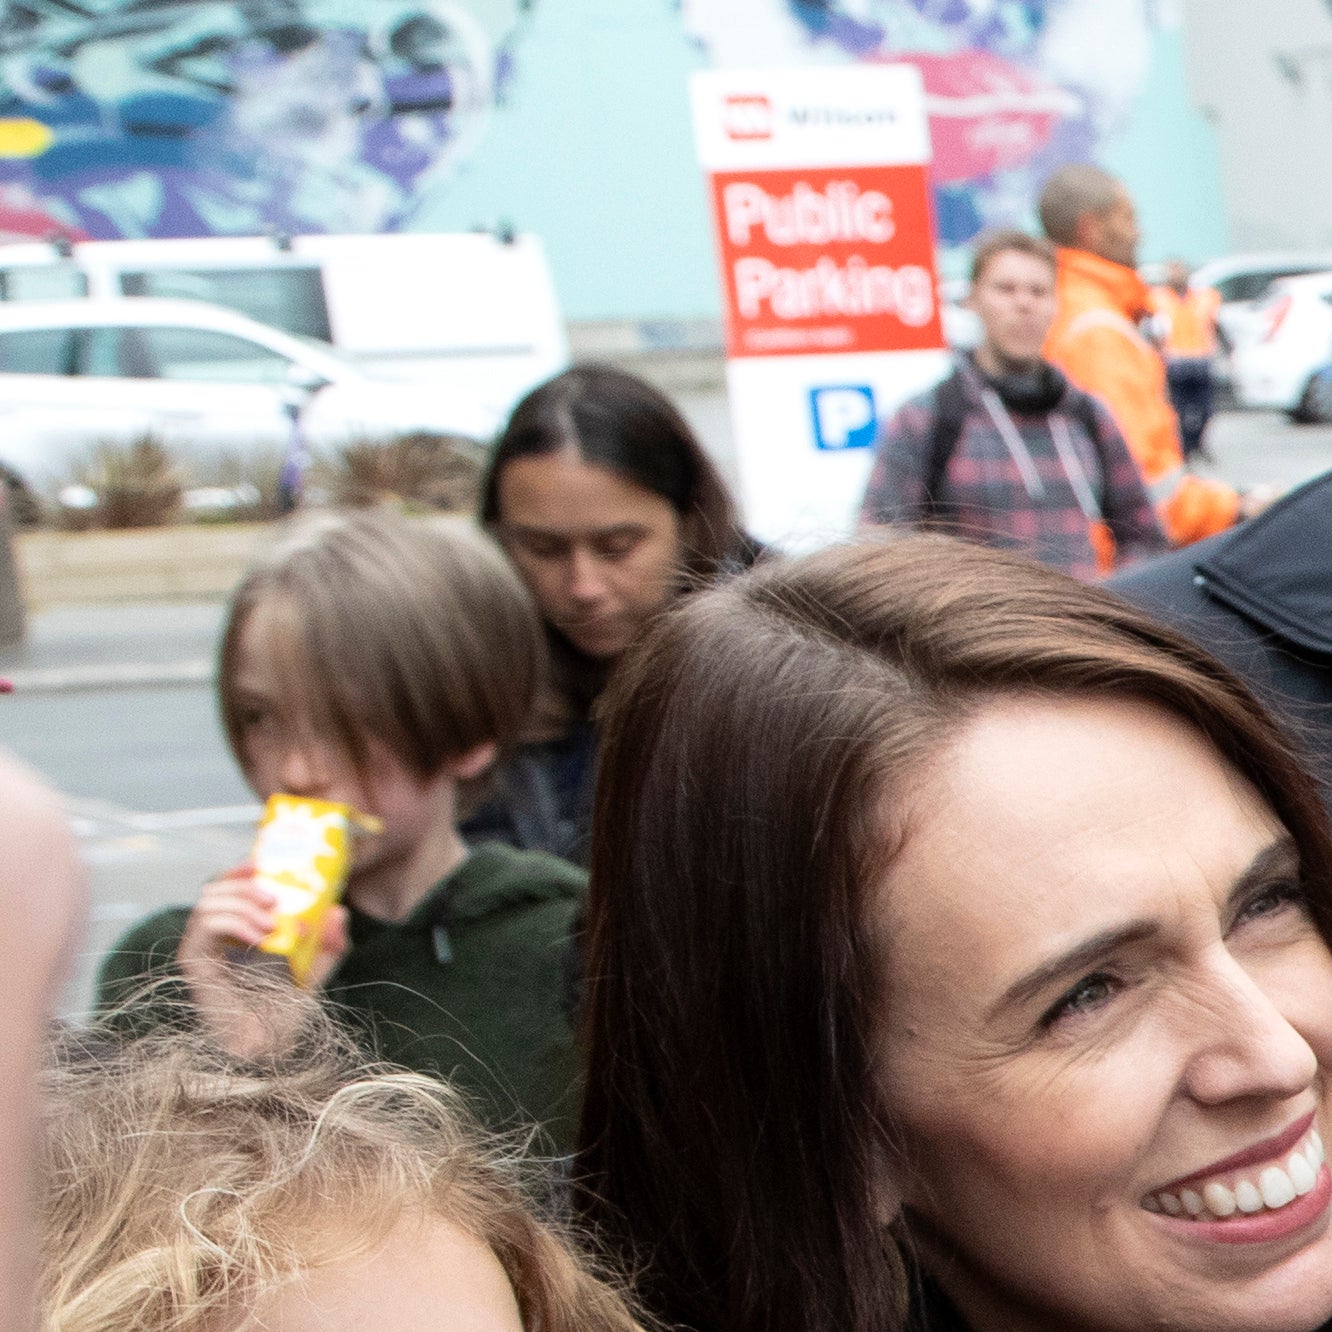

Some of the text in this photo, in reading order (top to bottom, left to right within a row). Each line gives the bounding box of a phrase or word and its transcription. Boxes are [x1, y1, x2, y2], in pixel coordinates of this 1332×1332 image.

[725, 181, 895, 246] Public
[734, 254, 933, 327] Parking
[816, 388, 872, 448] P
